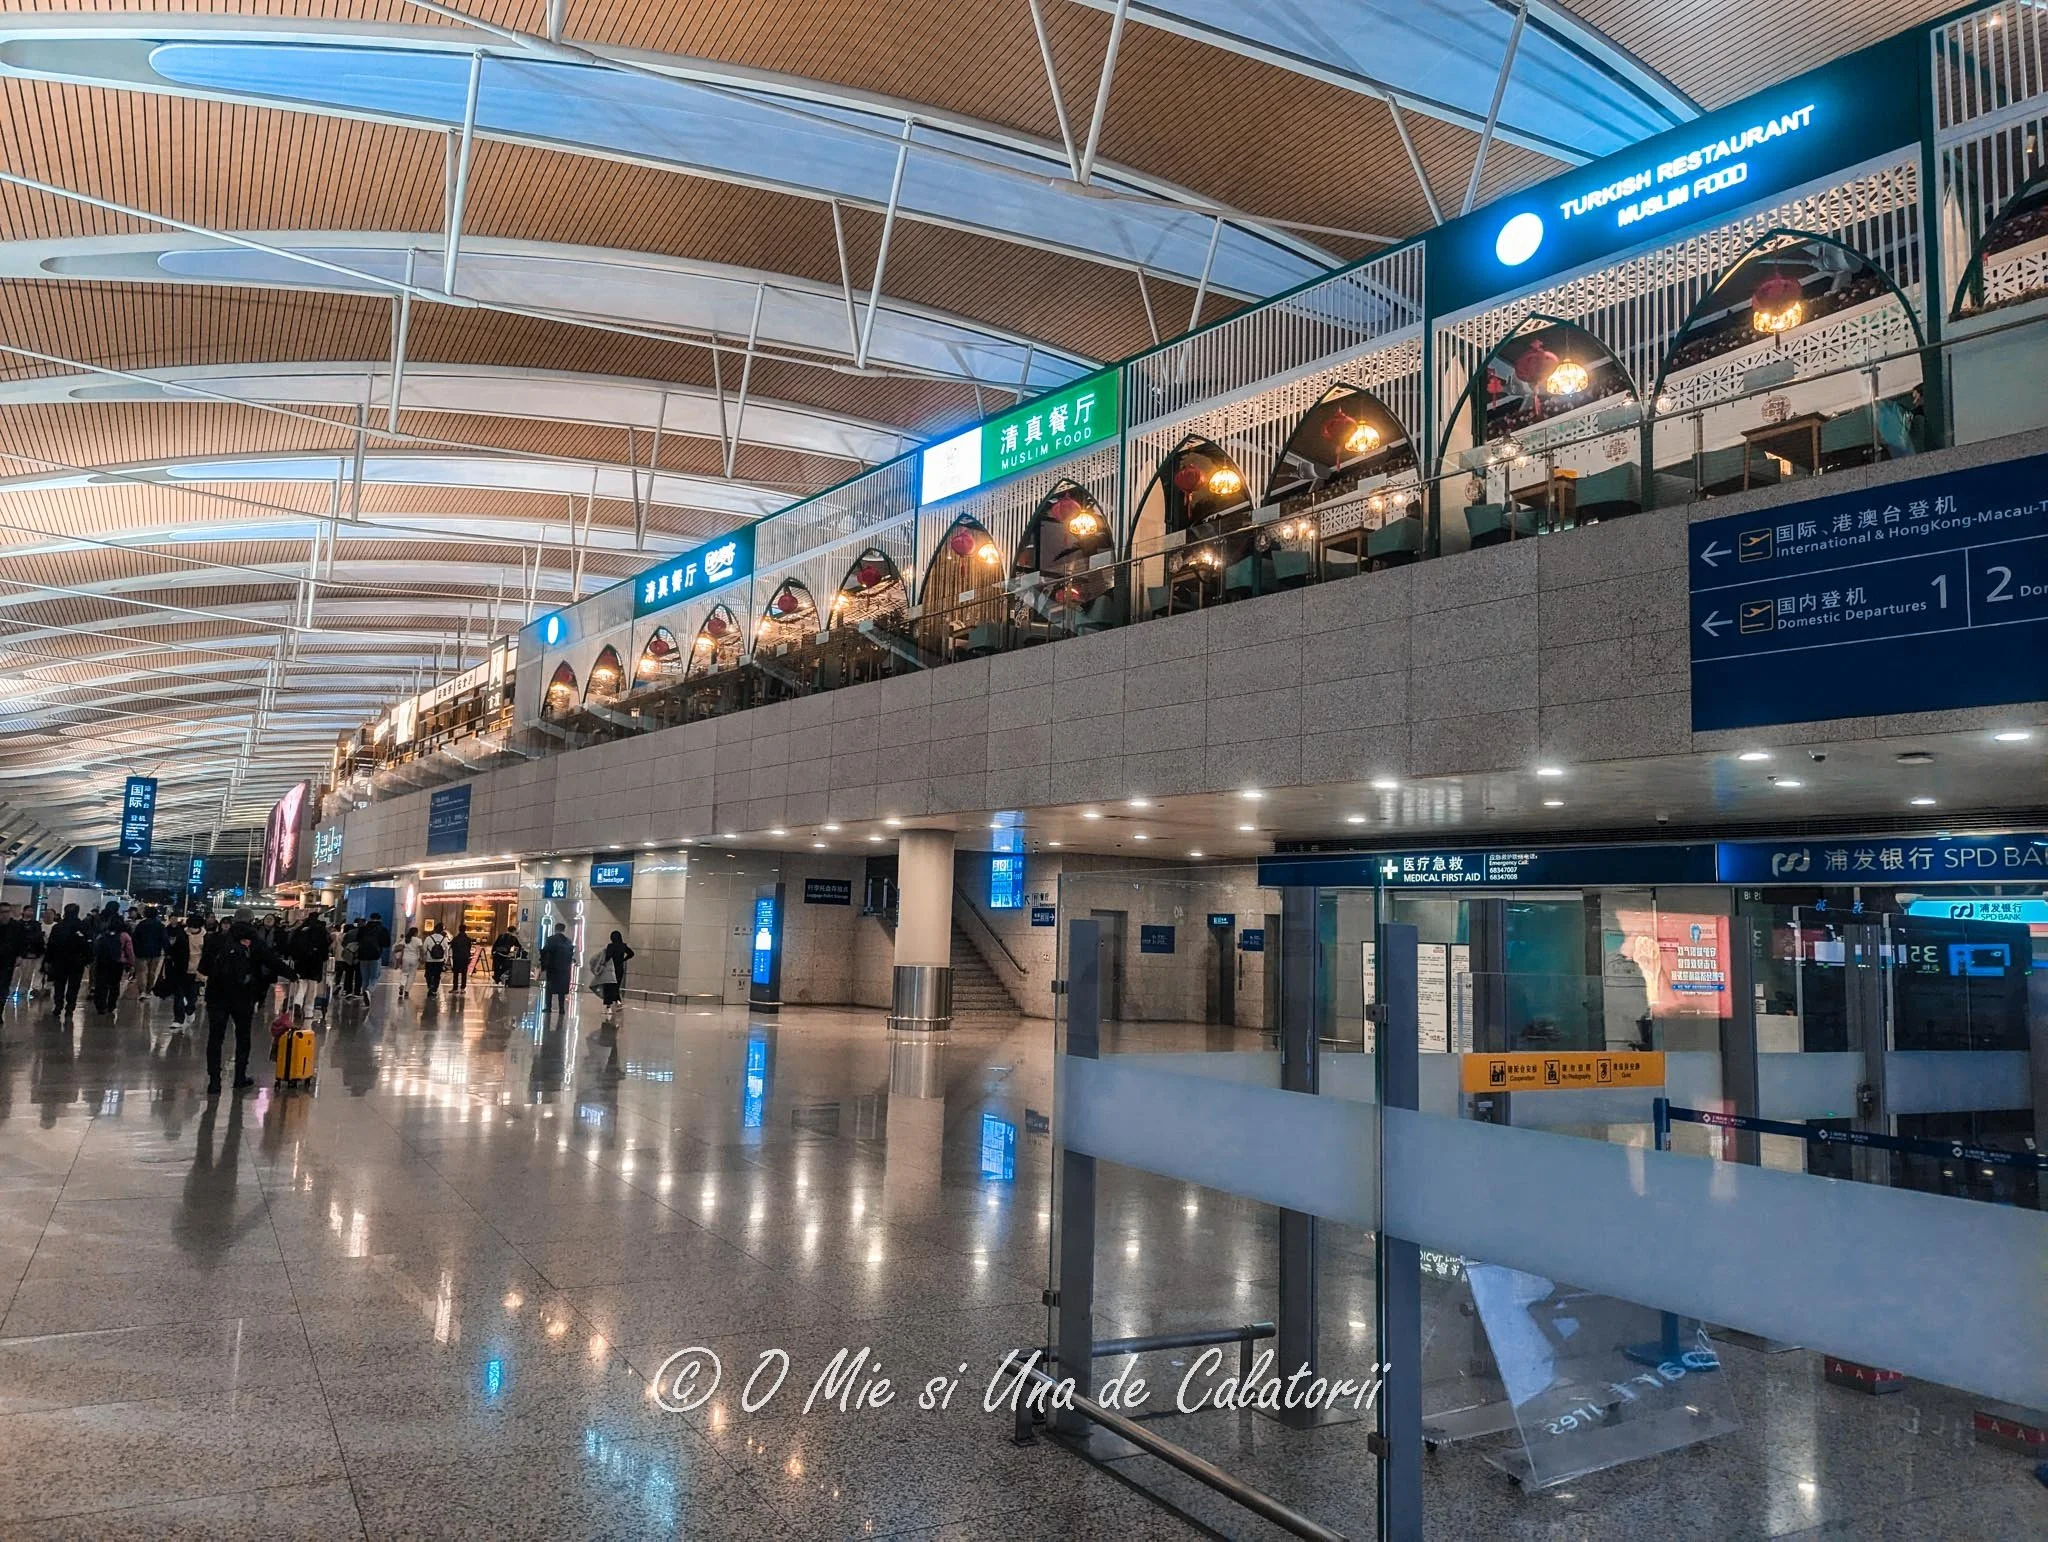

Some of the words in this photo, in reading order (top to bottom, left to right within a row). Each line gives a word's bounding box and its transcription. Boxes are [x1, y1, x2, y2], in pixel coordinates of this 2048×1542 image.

[1560, 169, 1651, 219] TURKISH
[1656, 104, 1815, 184] RESTAURANT
[1617, 185, 1689, 227] MUSLIM
[1693, 162, 1748, 198] FOOD
[1000, 393, 1095, 456] 清真餐厅
[1001, 443, 1048, 471] MUSLIM
[1055, 427, 1092, 450] FOOD
[1776, 495, 1957, 544] 国际、港澳台登机
[1776, 531, 1871, 557] International
[1874, 529, 1885, 540] &
[1931, 574, 1948, 609] 1
[1986, 566, 2014, 603] 2
[1777, 587, 1867, 616] 国内登机
[1777, 611, 1841, 630] Domestic
[1845, 601, 1927, 622] Departures
[129, 784, 144, 808] 国际
[1403, 856, 1464, 872] 医疗急救
[1489, 866, 1518, 874] 68347007
[1824, 847, 1935, 871] 浦发银行
[1944, 848, 1998, 868] SPD
[1404, 874, 1440, 882] MEDICAL
[1442, 873, 1464, 882] FIRST
[1465, 873, 1481, 882] AID
[1980, 902, 2022, 913] 浦发银行
[1980, 913, 1998, 921] SPD
[1998, 913, 2022, 921] BANK
